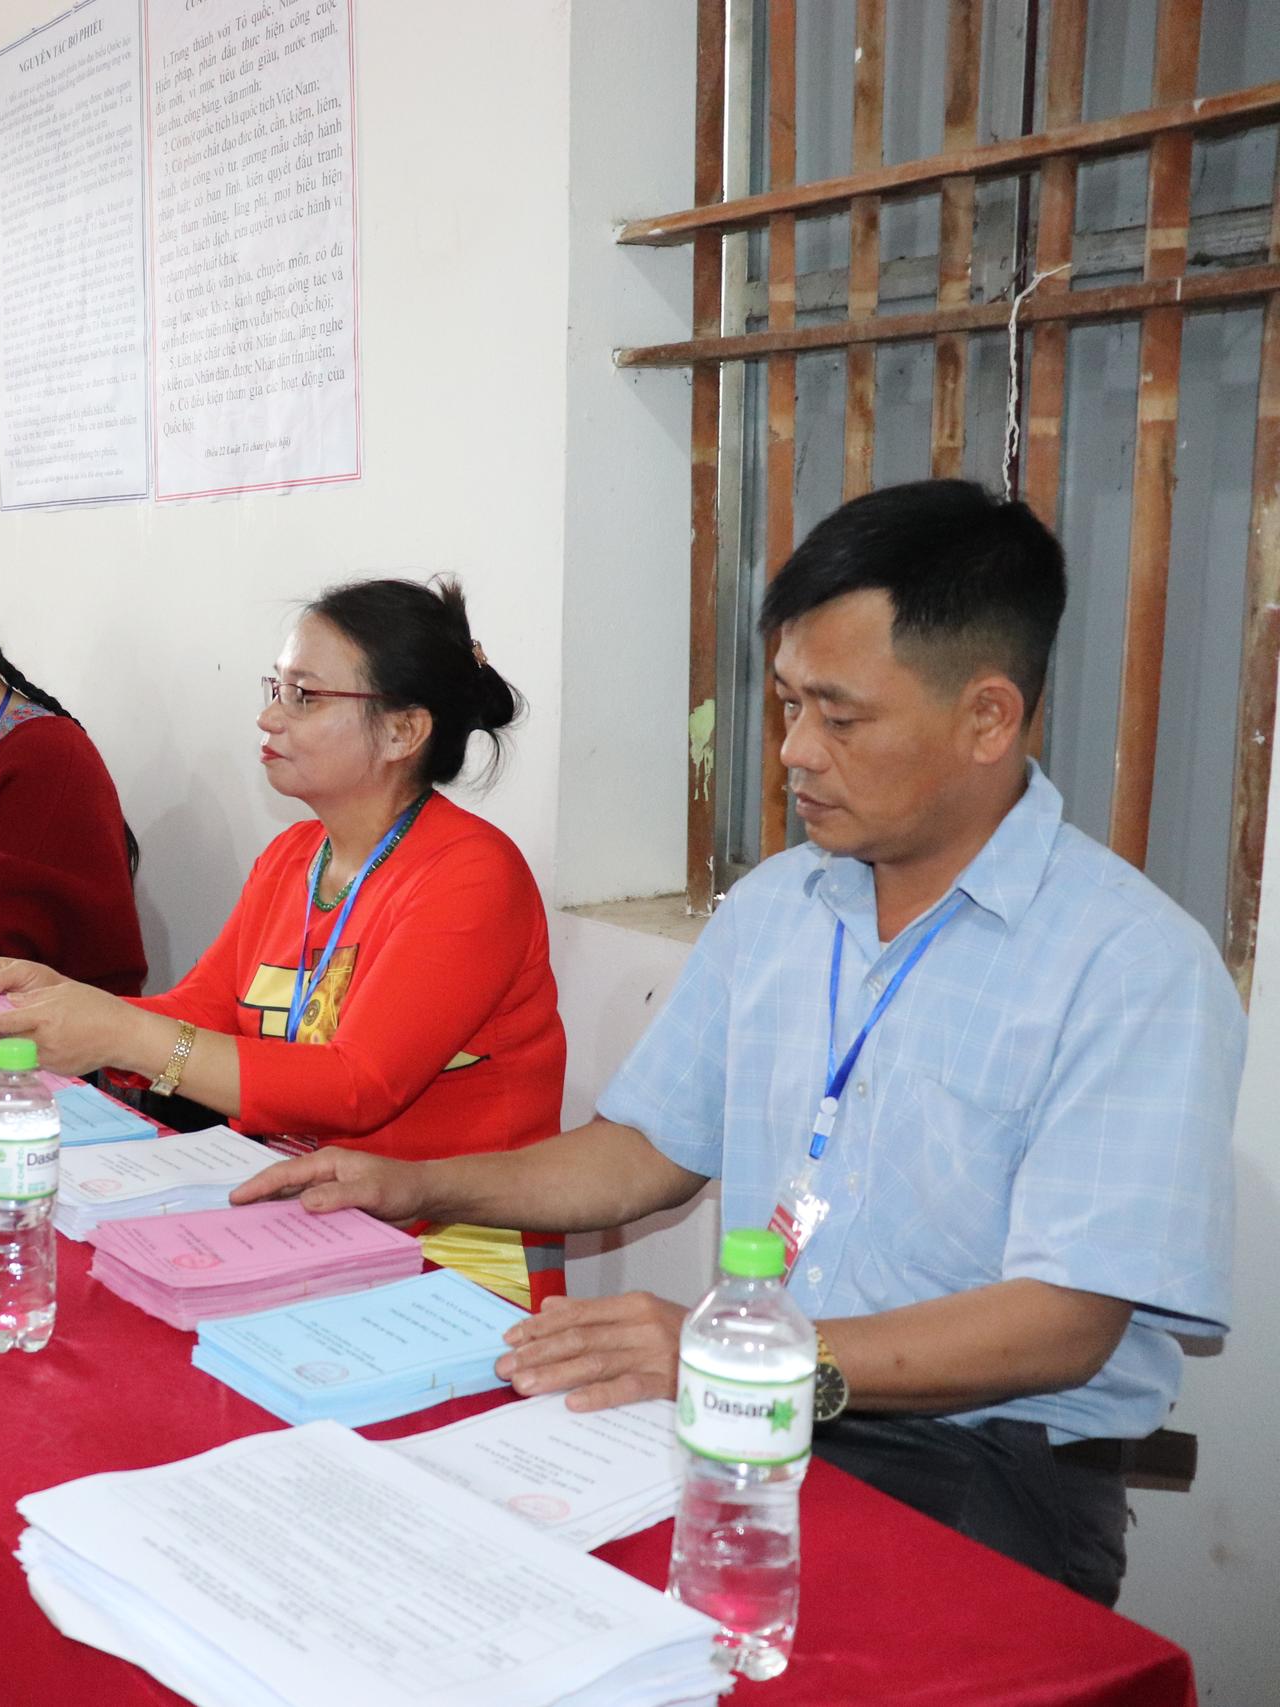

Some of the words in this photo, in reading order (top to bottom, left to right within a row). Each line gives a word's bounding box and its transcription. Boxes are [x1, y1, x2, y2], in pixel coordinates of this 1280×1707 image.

[317, 143, 343, 163] tranh
[320, 317, 343, 337] nghe
[26, 1149, 59, 1167] Dasa
